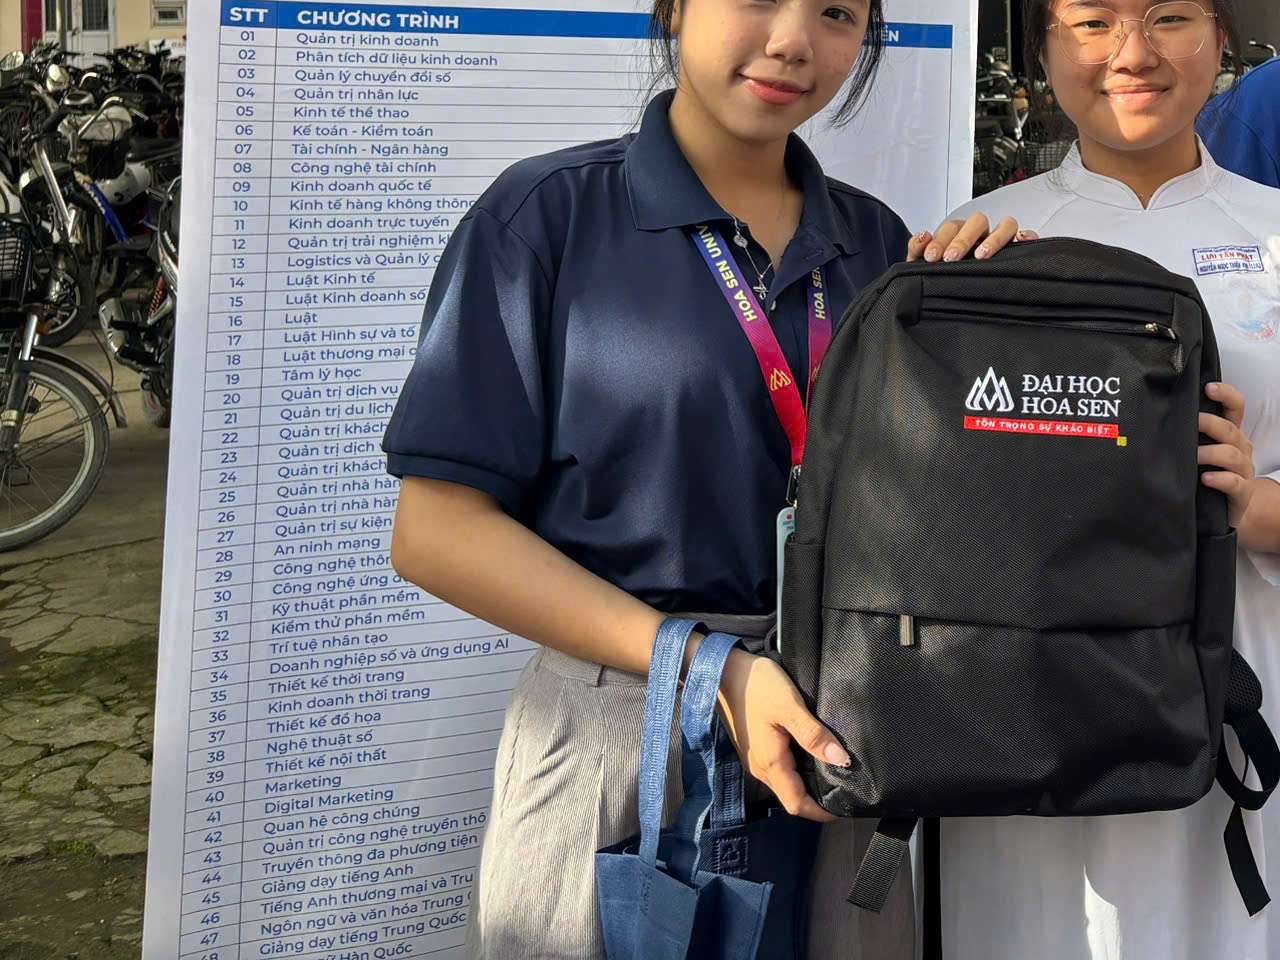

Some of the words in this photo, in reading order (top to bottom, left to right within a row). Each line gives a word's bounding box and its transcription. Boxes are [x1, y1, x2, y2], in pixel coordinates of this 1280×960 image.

[229, 7, 268, 23] STT
[297, 10, 391, 27] CHƯƠNG
[396, 11, 460, 29] TRÌNH
[241, 31, 254, 41] 01
[297, 33, 335, 45] Quản
[341, 34, 355, 47] trị
[360, 35, 390, 45] kinh
[395, 36, 438, 46] doanh
[238, 68, 255, 79] 03
[295, 69, 334, 81] Quản
[339, 70, 351, 83] lý
[354, 71, 406, 83] chuyển
[410, 71, 431, 82] đổi
[436, 72, 451, 82] số
[236, 106, 253, 116] 05
[294, 106, 326, 117] Kinh
[331, 106, 346, 117] tế
[350, 106, 373, 117] thể
[377, 107, 409, 118] thao
[234, 144, 252, 154] 07
[292, 144, 312, 155] Tài
[316, 144, 357, 155] chính
[371, 144, 408, 156] Ngân
[413, 144, 448, 156] hàng
[233, 181, 251, 192] 09
[291, 181, 324, 191] Kinh
[328, 181, 374, 191] doanh
[378, 179, 414, 193] quốc
[418, 179, 432, 190] tế
[234, 220, 244, 230] 11
[289, 218, 322, 229] Kinh
[326, 217, 373, 228] doanh
[377, 218, 405, 229] trực
[410, 215, 449, 229] tuyến
[230, 277, 244, 287] 14
[286, 275, 319, 287] Luật
[324, 273, 356, 284] Kinh
[361, 272, 375, 283] tế
[715, 259, 739, 290] SEN
[733, 289, 758, 322] HOA
[813, 292, 826, 320] HOA
[228, 315, 242, 327] 16
[285, 312, 318, 325] Luật
[226, 370, 240, 384] 19
[282, 370, 313, 381] Tâm
[319, 368, 330, 381] lý
[335, 368, 361, 380] học
[1022, 374, 1064, 395] ĐẠI
[1067, 376, 1121, 398] HỌC
[1021, 396, 1073, 416] HOA
[1077, 399, 1121, 418] SEN
[975, 418, 996, 428] TÔN
[1055, 423, 1083, 434] KHÁC
[216, 551, 233, 563] 28
[274, 545, 294, 556] An
[300, 540, 332, 553] ninh
[338, 538, 380, 549] mạng
[215, 610, 228, 622] 31
[273, 602, 290, 616] Kỹ
[294, 598, 335, 612] thuật
[339, 594, 376, 612] phần
[382, 590, 419, 603] mềm
[212, 650, 228, 662] 33
[269, 641, 289, 654] Trí
[293, 639, 318, 652] tuệ
[322, 635, 359, 648] nhân
[365, 634, 388, 644] tạo
[208, 730, 225, 743] 37
[266, 718, 304, 733] Thiết
[310, 715, 327, 728] kế
[331, 712, 350, 725] đồ
[355, 712, 381, 724] họa
[206, 771, 224, 783] 39
[265, 758, 304, 773] Thiết
[308, 754, 326, 768] kế
[330, 752, 352, 766] nội
[357, 748, 386, 762] thất
[205, 791, 224, 803] 40
[265, 776, 341, 794] Marketing
[207, 811, 220, 823] 41
[265, 797, 313, 813] Digital
[319, 789, 393, 807] Marketing
[202, 872, 221, 884] 44
[262, 857, 313, 874] Truyền
[318, 854, 362, 866] thông
[367, 849, 385, 860] đa
[390, 841, 446, 860] phương
[451, 834, 478, 848] tiện
[202, 892, 220, 904] 45
[262, 880, 305, 894] Giảng
[310, 876, 337, 888] dạy
[341, 870, 379, 883] tiếng
[384, 864, 413, 878] Anh
